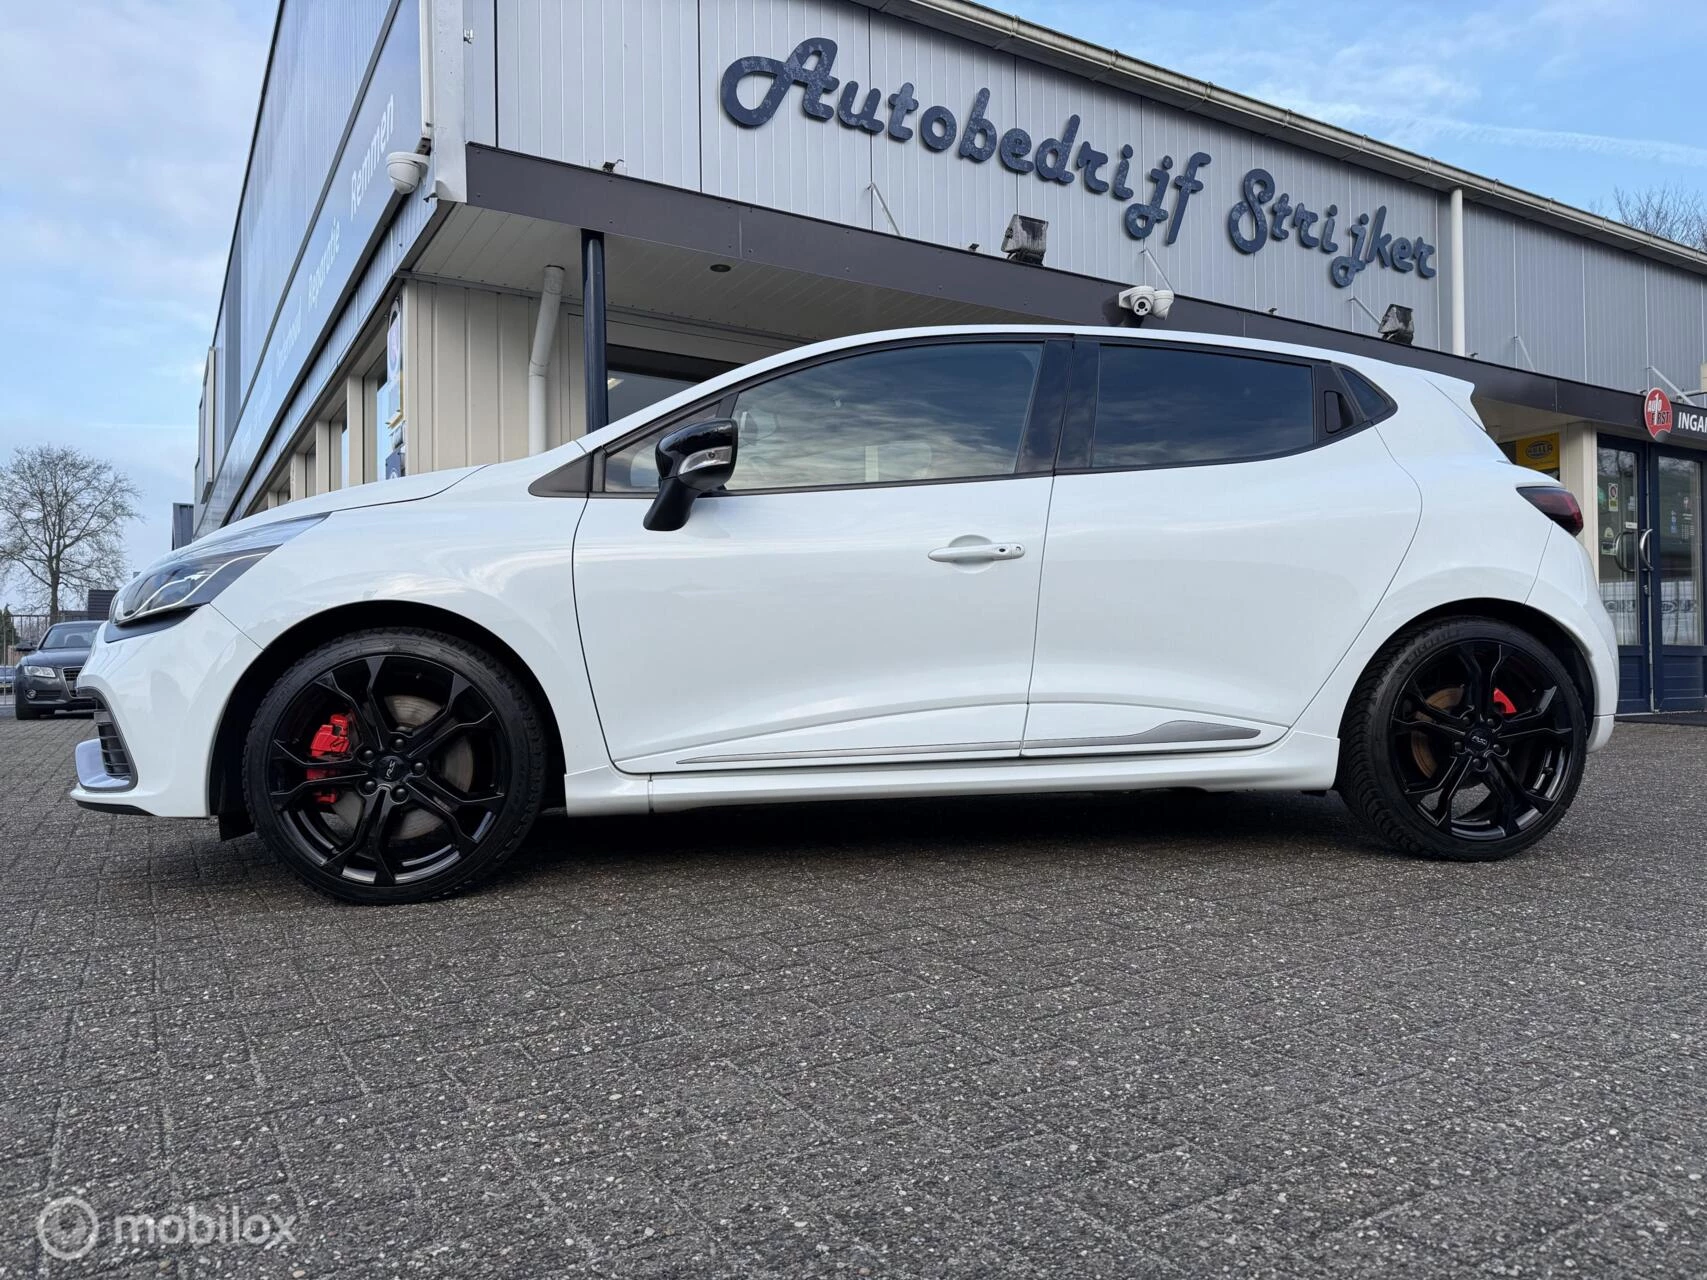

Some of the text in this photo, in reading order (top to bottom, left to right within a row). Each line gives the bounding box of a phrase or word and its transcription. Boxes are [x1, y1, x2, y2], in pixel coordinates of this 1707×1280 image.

[308, 216, 341, 312] Reparatie
[351, 94, 394, 222] Remmen
[720, 37, 1436, 287] Autobedrijf Strijker
